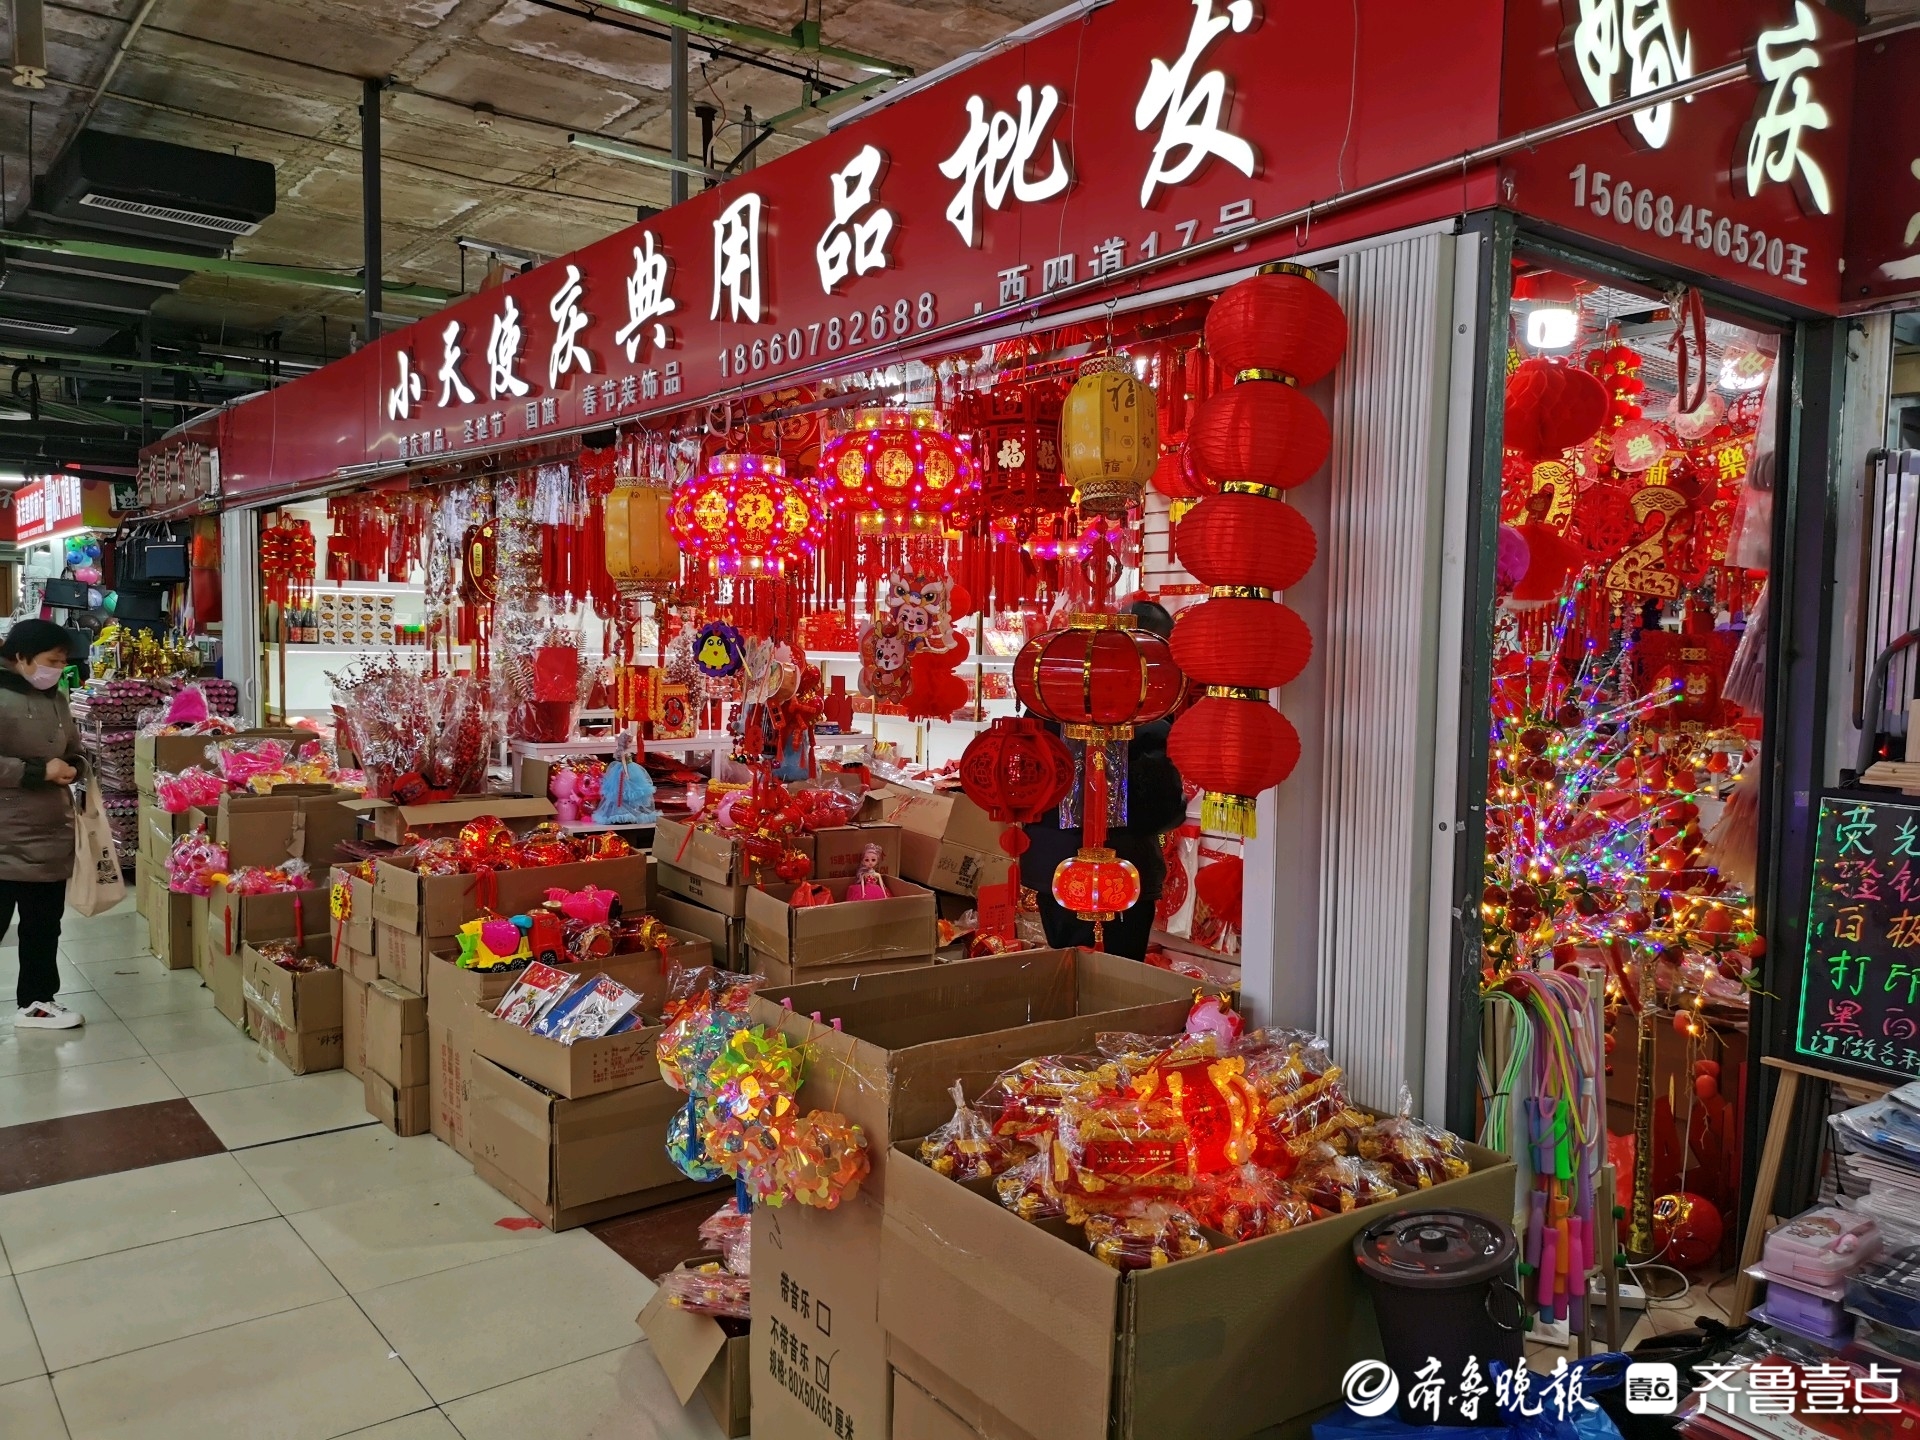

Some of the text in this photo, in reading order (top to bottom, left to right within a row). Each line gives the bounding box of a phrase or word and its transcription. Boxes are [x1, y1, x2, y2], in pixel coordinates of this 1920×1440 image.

[388, 0, 1256, 421] 小天使庆典用品批发
[1568, 162, 1809, 286] 15668456520王
[525, 396, 559, 431] 国旗
[582, 360, 683, 417] 春节装饰品
[717, 291, 936, 378] 18660782688
[997, 198, 1259, 297] 西四道17号
[996, 438, 1025, 469] 福
[1827, 949, 1920, 1004] 打印
[779, 1270, 811, 1320] 带音乐
[769, 1314, 810, 1373] 不带音乐
